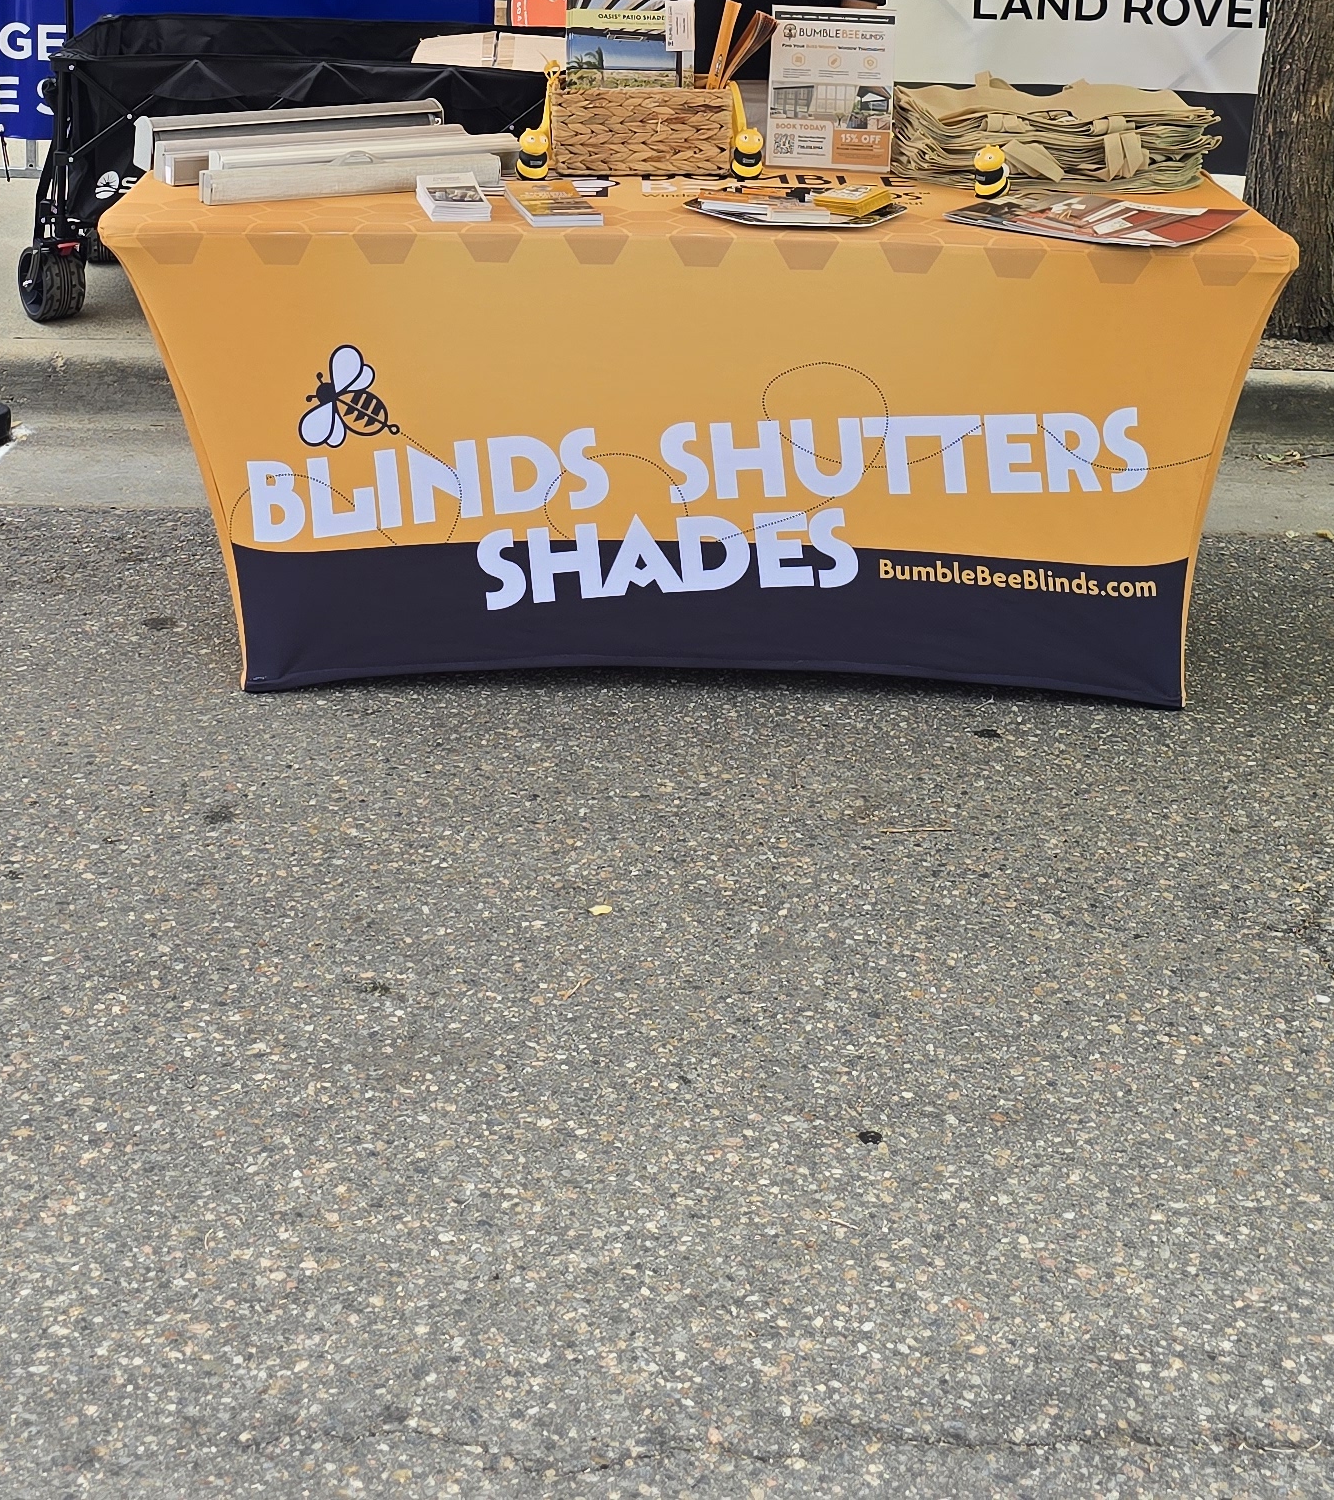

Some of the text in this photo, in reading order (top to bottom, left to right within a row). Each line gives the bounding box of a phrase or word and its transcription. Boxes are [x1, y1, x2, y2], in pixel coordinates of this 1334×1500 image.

[642, 14, 666, 22] SHADE
[775, 122, 798, 130] BOOK
[840, 133, 882, 145] 15% OFF
[245, 406, 1149, 544] BLINDS SHUTTERS
[474, 506, 859, 612] SHADES
[877, 556, 1158, 600] BumbleBeeBlinds.com
